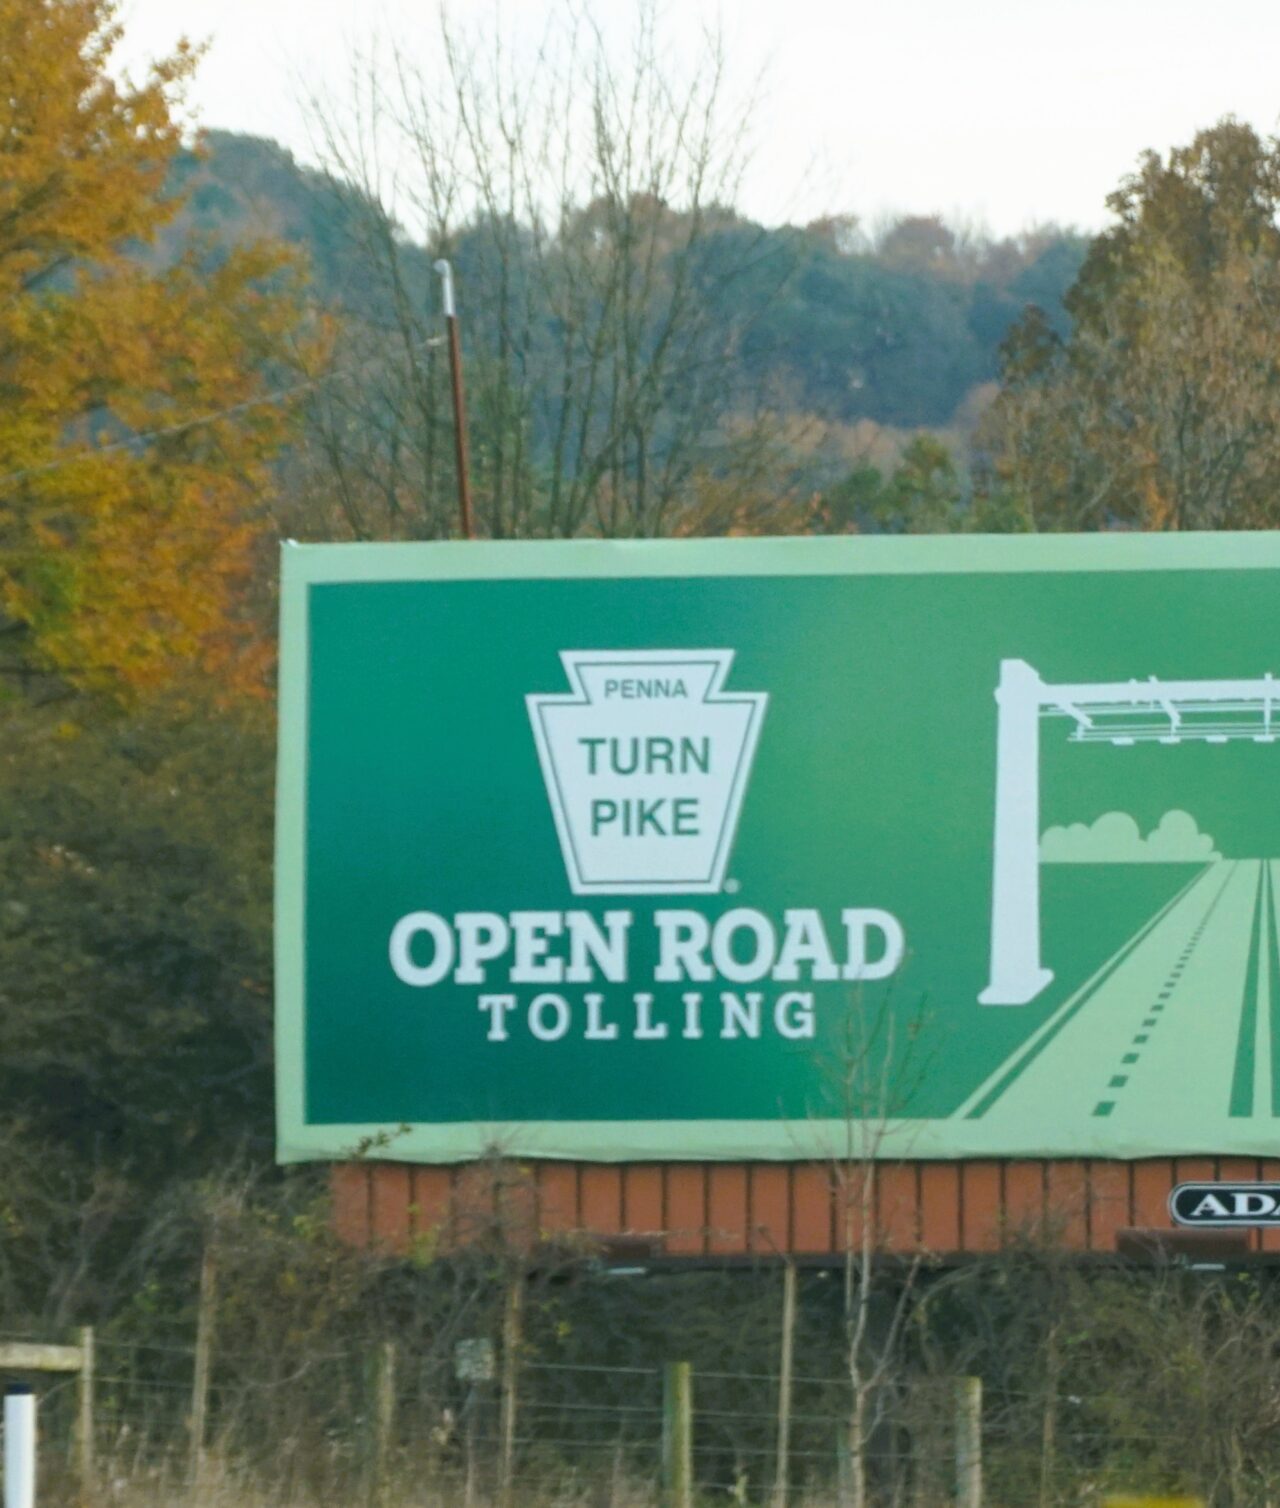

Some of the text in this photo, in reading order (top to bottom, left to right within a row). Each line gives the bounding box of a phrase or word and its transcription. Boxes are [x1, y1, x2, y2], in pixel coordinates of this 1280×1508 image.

[603, 679, 688, 699] PENNA
[578, 736, 711, 775] TURN
[591, 798, 701, 837] PIKE
[388, 908, 905, 987] OPEN ROAD
[478, 993, 816, 1041] TOLLING
